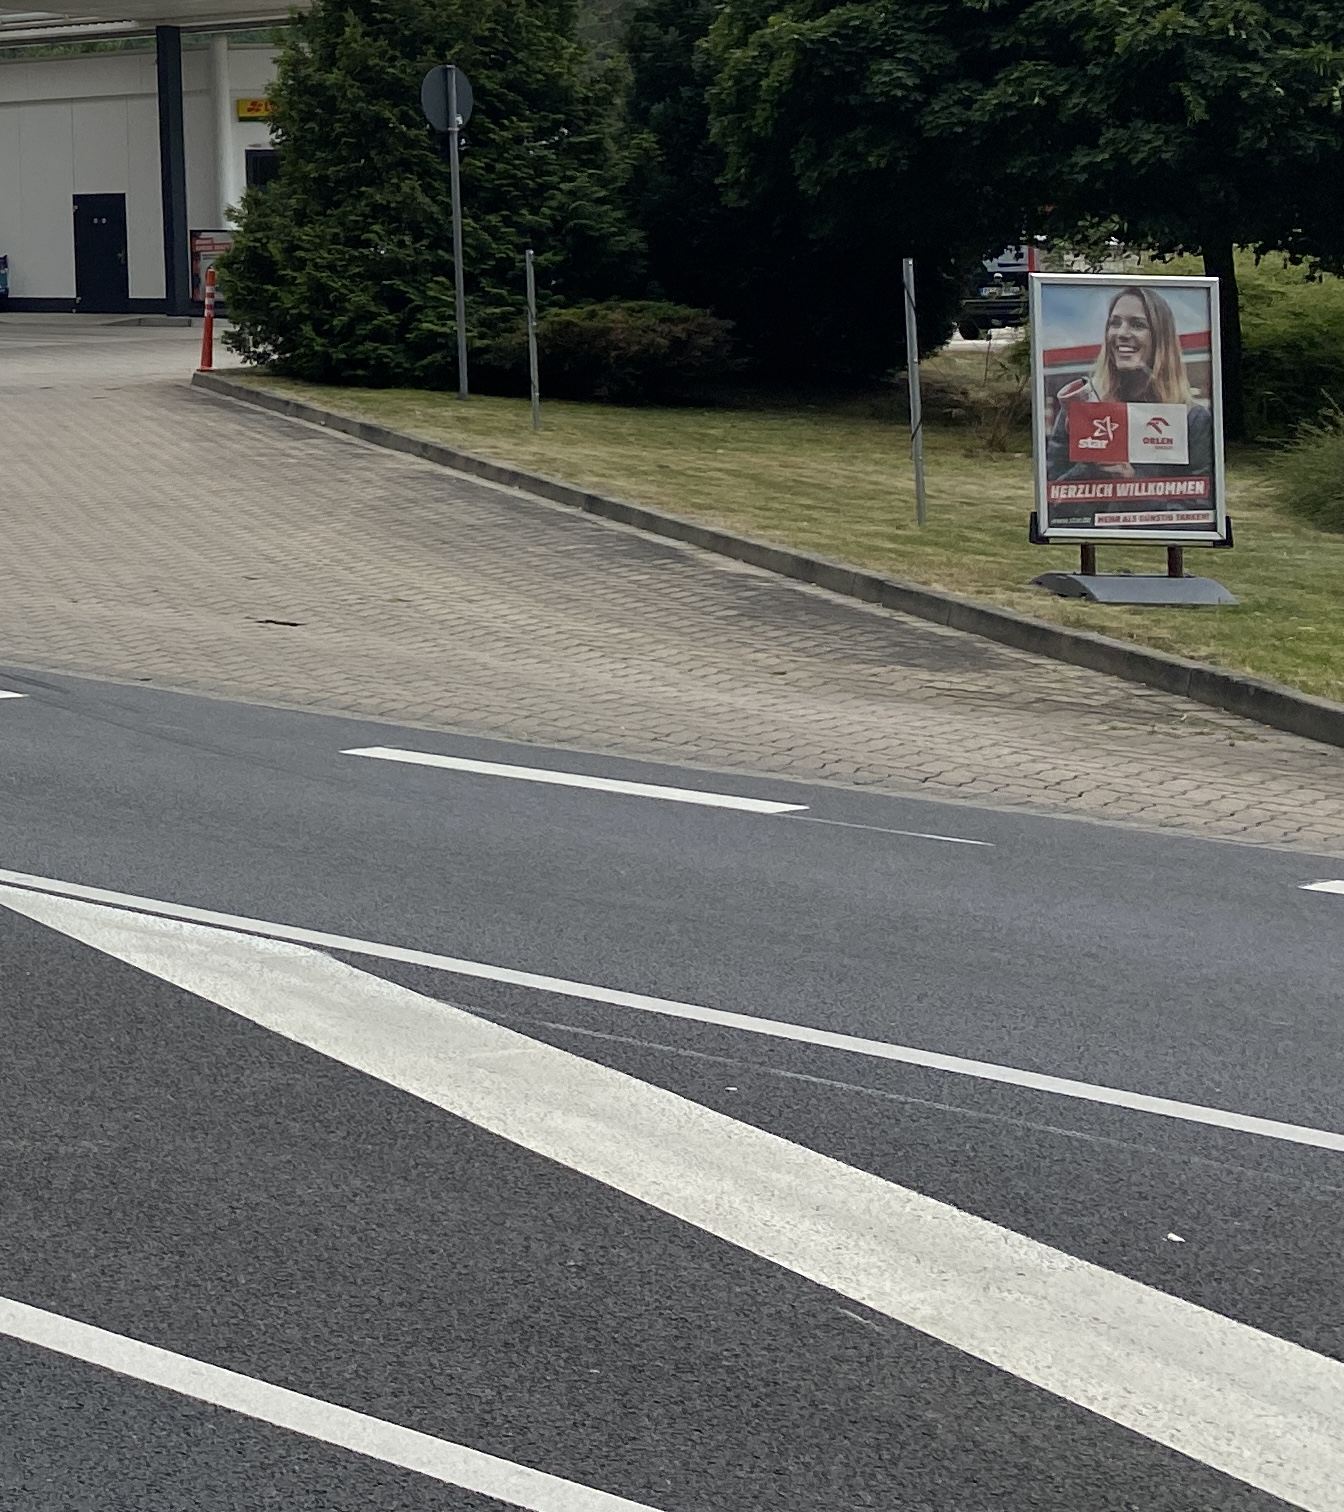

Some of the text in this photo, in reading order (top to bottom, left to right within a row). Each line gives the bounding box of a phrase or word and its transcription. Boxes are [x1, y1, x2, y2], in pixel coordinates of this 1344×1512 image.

[1078, 436, 1109, 449] star
[1142, 437, 1174, 445] ORLEN
[1050, 480, 1205, 499] HERZLICH WILLKOMMEN
